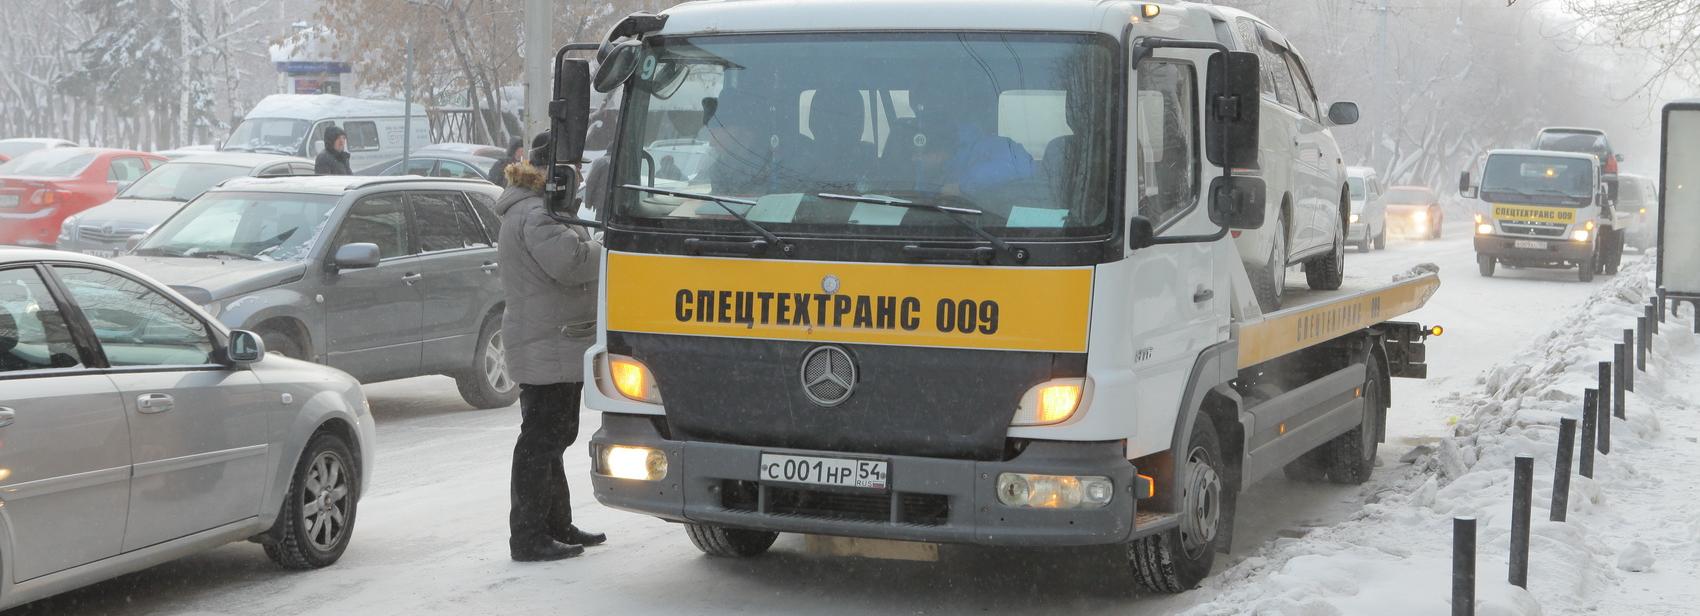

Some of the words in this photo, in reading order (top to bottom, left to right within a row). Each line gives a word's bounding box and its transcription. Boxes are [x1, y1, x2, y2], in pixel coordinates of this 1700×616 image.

[675, 288, 921, 331] СПЕЦТЕХТРАНС
[936, 298, 999, 335] 009
[859, 462, 880, 480] 54
